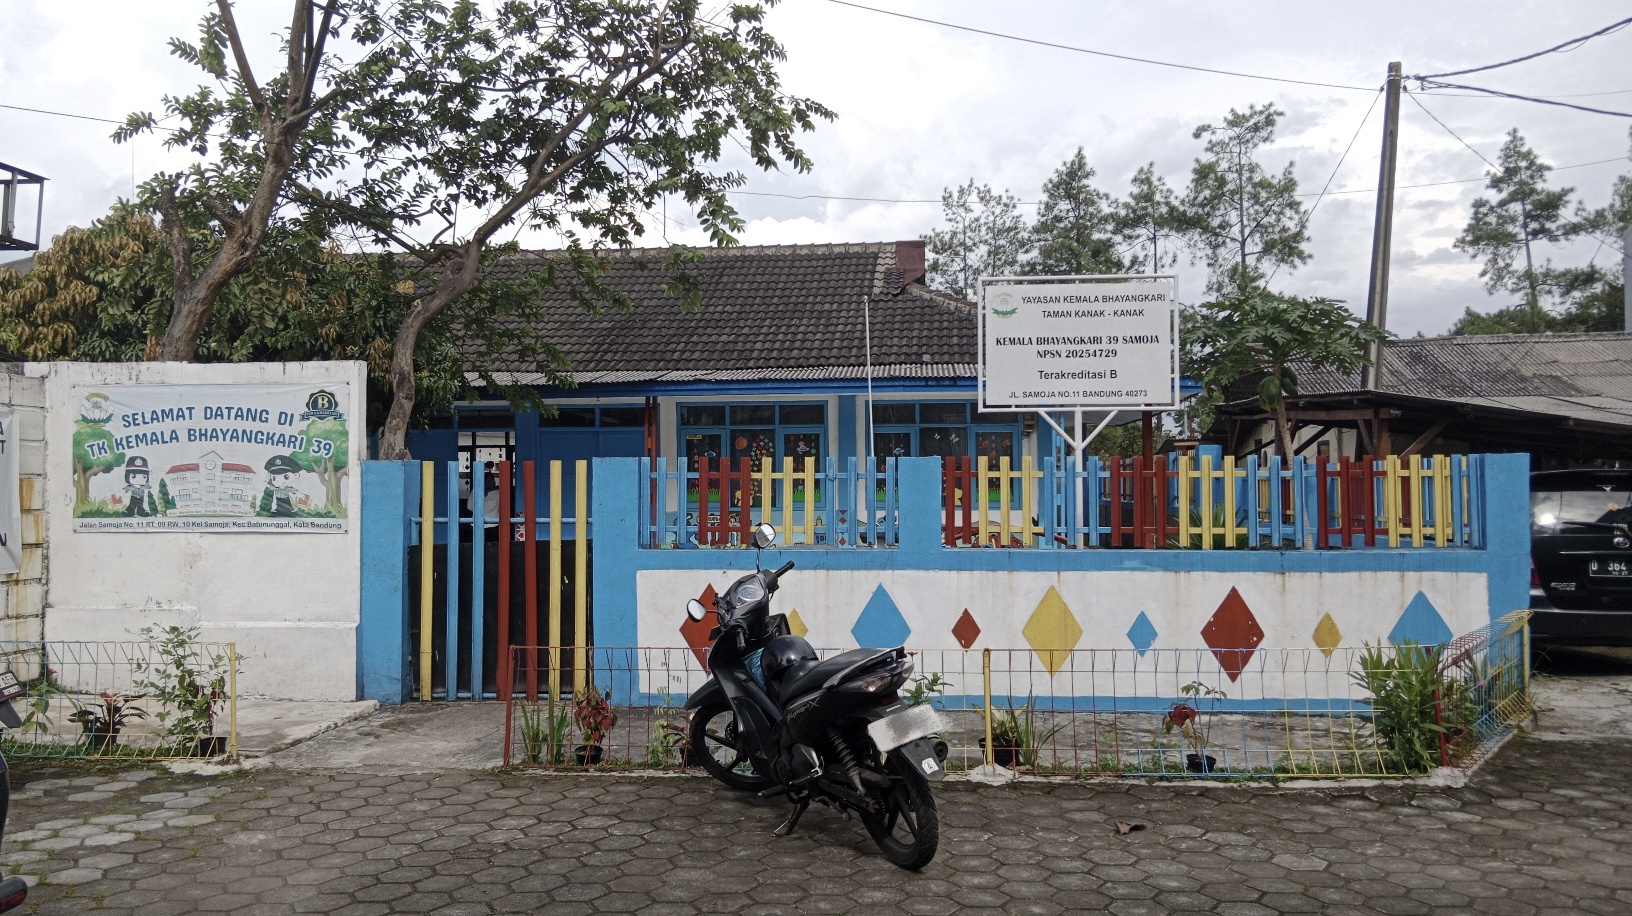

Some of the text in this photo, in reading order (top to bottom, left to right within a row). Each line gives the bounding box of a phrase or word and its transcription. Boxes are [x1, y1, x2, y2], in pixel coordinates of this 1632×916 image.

[1021, 293, 1166, 304] YAYASAN KEMALA BHAYANGKARI
[1041, 310, 1072, 319] TAMAN
[1074, 309, 1106, 318] KANAK
[1113, 308, 1145, 318] KANAK
[995, 334, 1160, 346] KEMALA BHAYANGKARI 39 SAMOJA
[1036, 349, 1118, 359] NPSN 20254729
[1038, 369, 1118, 380] Terakreditasi B
[1008, 389, 1148, 399] JL. SAMOJA NO.11 BANDUNG 40273
[317, 395, 329, 409] B
[121, 405, 295, 429] SELAMAT DATANG DI
[86, 427, 333, 459] TK KEMALA BHAYANGKARI 39
[79, 521, 97, 529] Jalan
[98, 521, 122, 530] Samoja
[293, 521, 310, 529] Kota
[310, 521, 342, 530] Bandung
